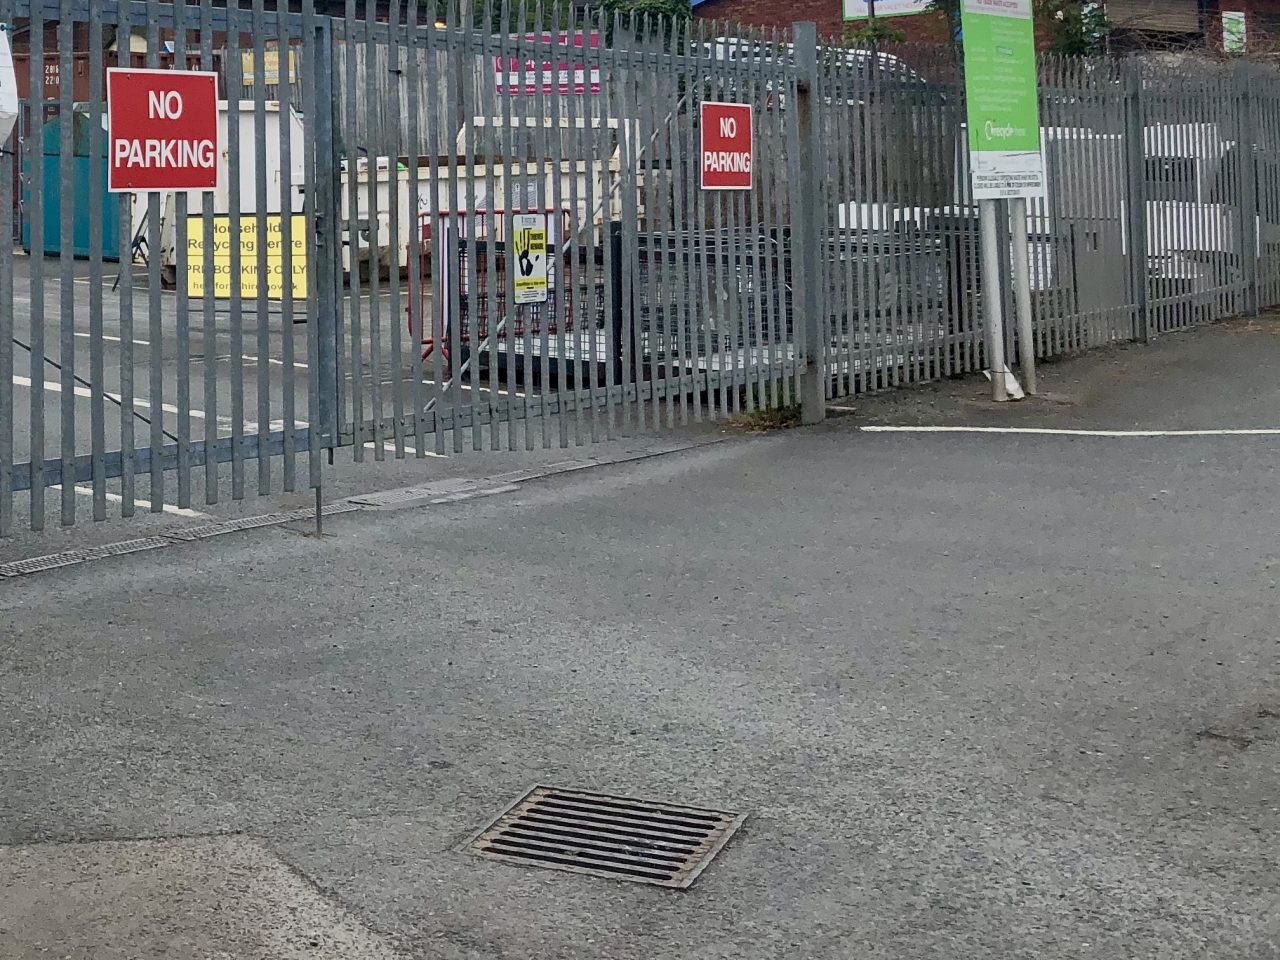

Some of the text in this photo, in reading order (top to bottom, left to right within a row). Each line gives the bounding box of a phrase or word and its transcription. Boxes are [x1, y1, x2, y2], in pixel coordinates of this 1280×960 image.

[149, 90, 183, 119] NO
[720, 117, 736, 138] NO
[115, 139, 214, 168] PARKING
[704, 152, 750, 172] PARKING
